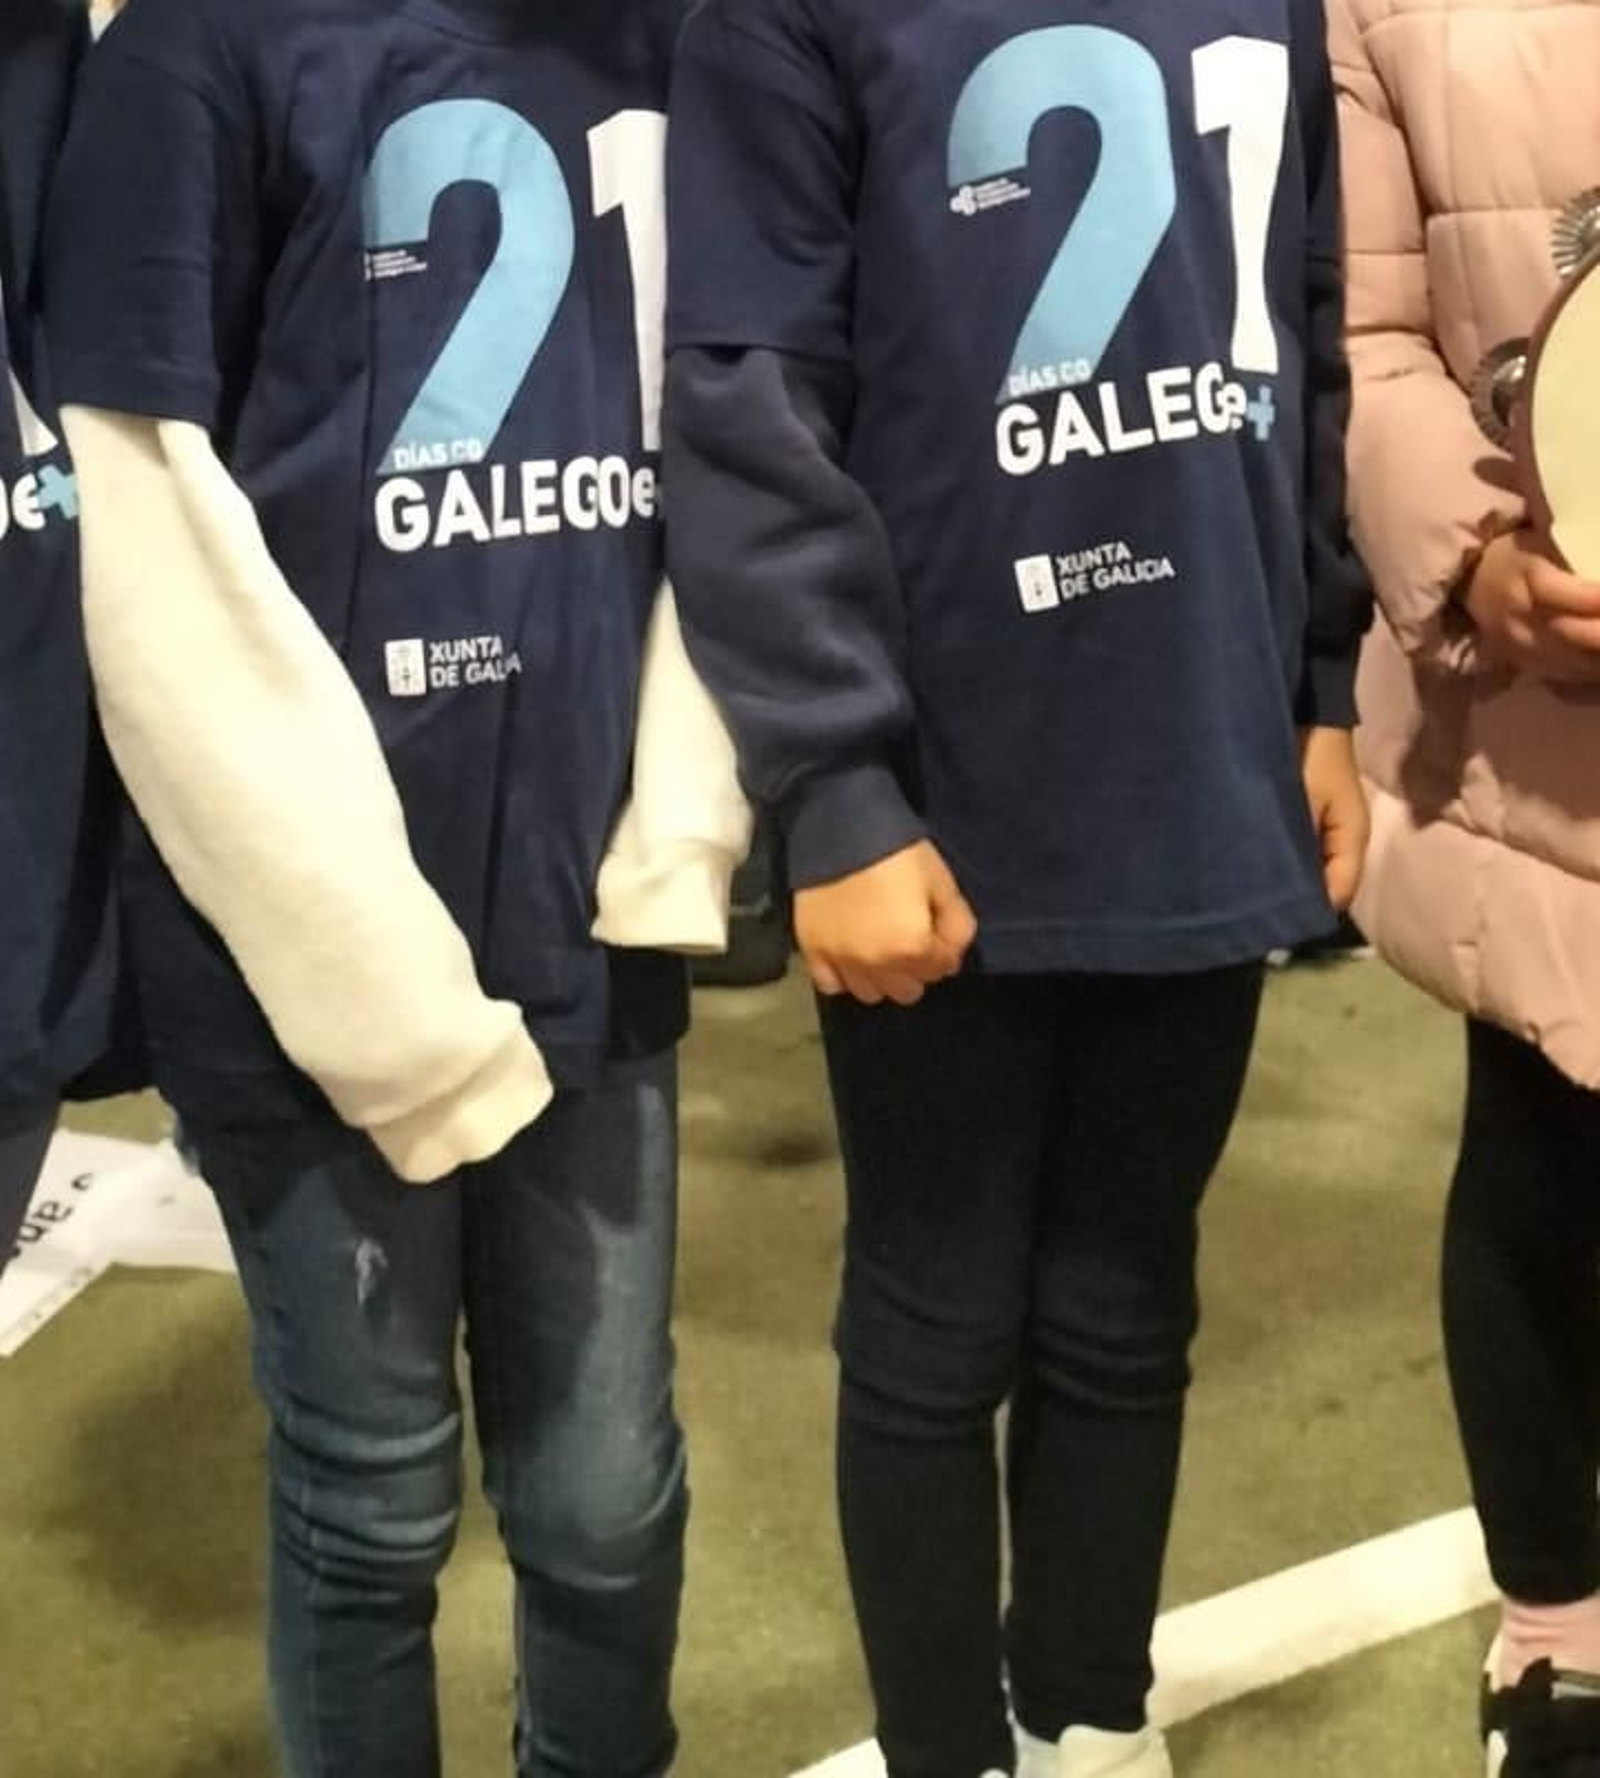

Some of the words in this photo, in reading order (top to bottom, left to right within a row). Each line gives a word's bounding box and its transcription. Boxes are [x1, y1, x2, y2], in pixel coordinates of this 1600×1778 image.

[947, 24, 1289, 404] 21
[362, 98, 667, 474] 21
[1007, 365, 1057, 397] DÍAS
[1060, 358, 1091, 383] CO
[394, 440, 448, 471] DÍAS
[451, 440, 483, 463] CO
[1056, 541, 1132, 574] XUNTA
[1061, 574, 1089, 600] DE
[1093, 557, 1175, 590] GALICIA
[430, 634, 503, 663] XUNTA
[430, 664, 459, 688] DE
